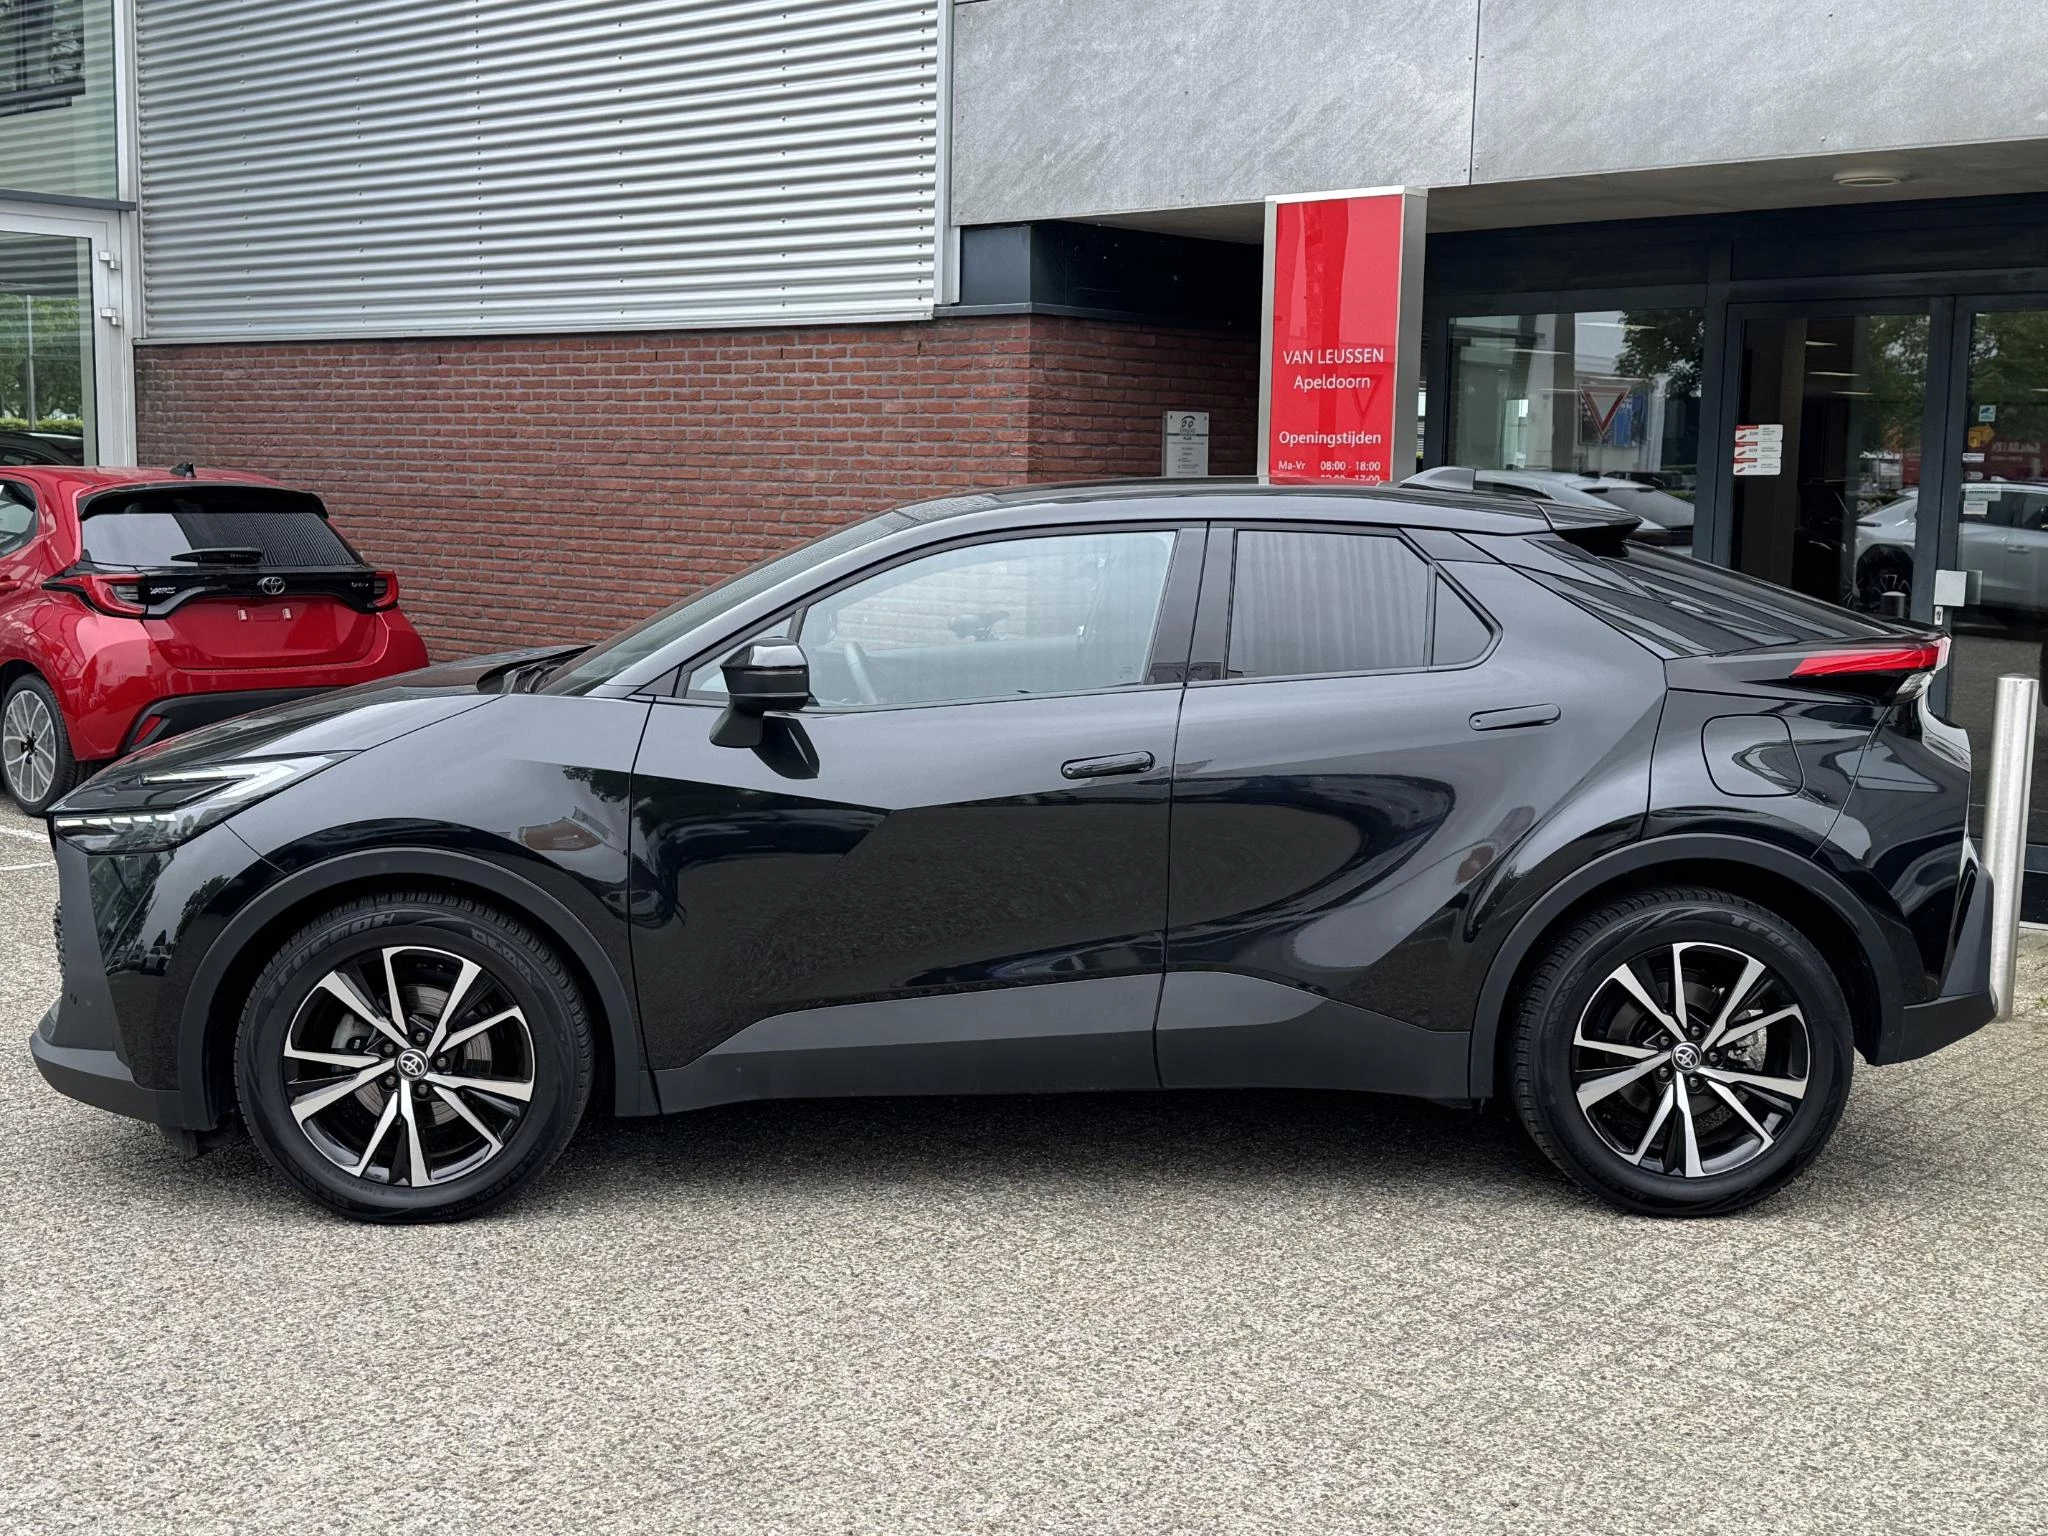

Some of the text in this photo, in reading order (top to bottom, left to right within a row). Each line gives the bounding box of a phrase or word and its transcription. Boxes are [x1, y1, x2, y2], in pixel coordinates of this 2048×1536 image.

[1283, 348, 1384, 365] VAN LEUSSEN
[1293, 374, 1371, 392] Apeldoorn
[1279, 430, 1382, 448] Openingstijden
[1278, 460, 1306, 471] Ma-Vr
[1320, 460, 1346, 471] 08:00
[1355, 461, 1381, 471] 18:00
